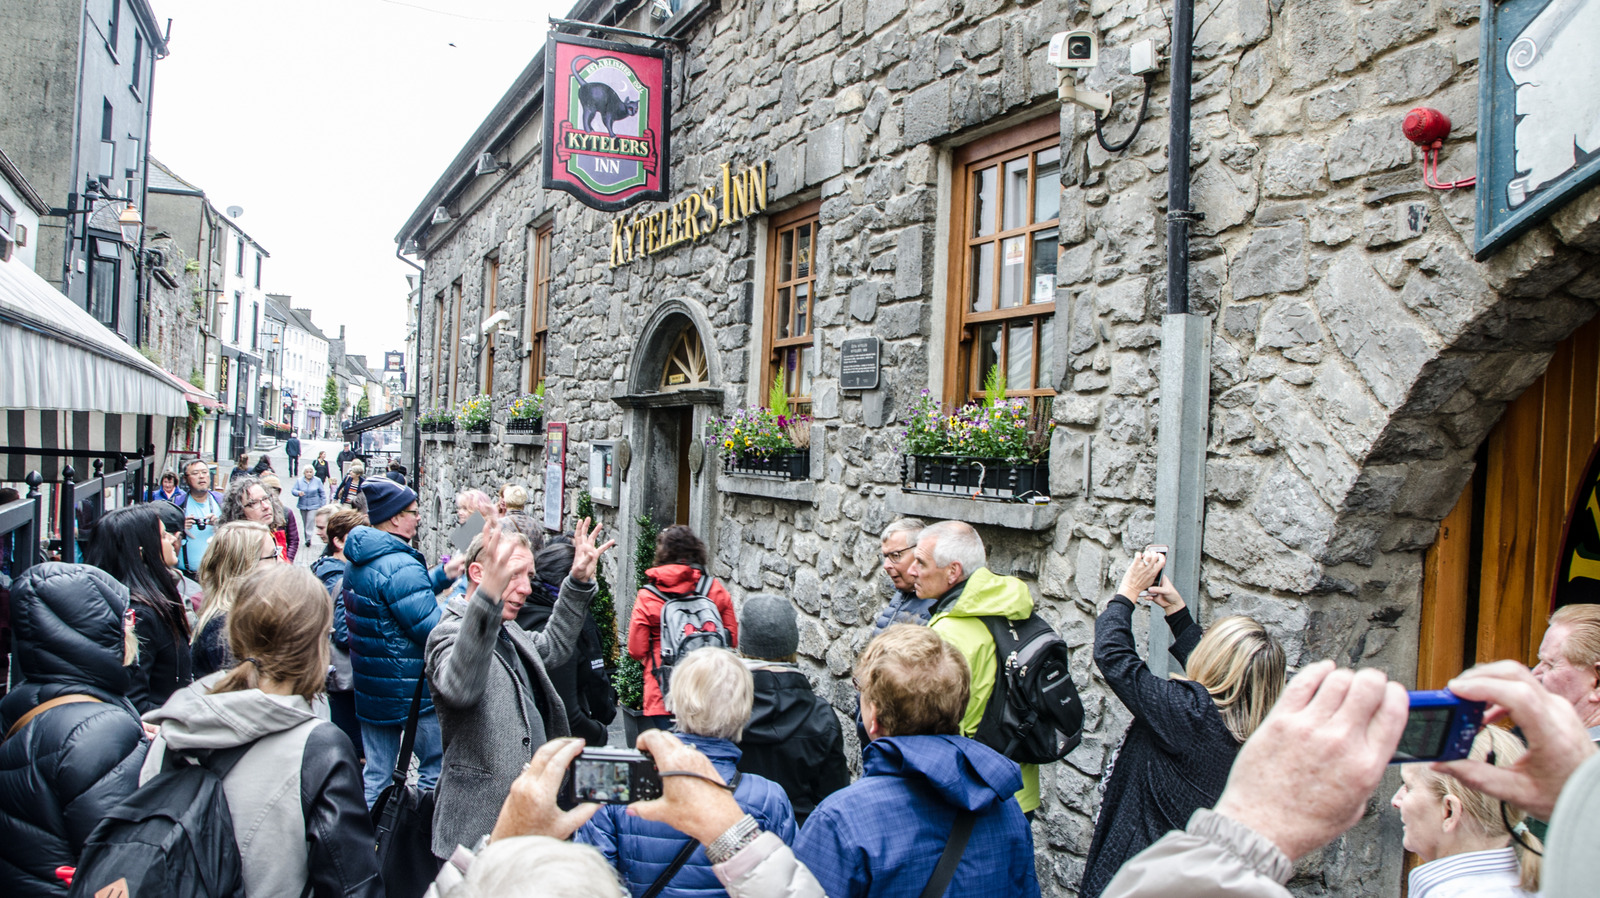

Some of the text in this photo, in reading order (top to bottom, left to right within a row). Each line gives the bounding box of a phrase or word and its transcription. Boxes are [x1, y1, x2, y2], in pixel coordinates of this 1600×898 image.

[586, 59, 631, 77] ESTABLISHED
[568, 132, 649, 156] KYTELERS
[594, 158, 620, 174] INN
[609, 161, 767, 270] KYTELERS INN
